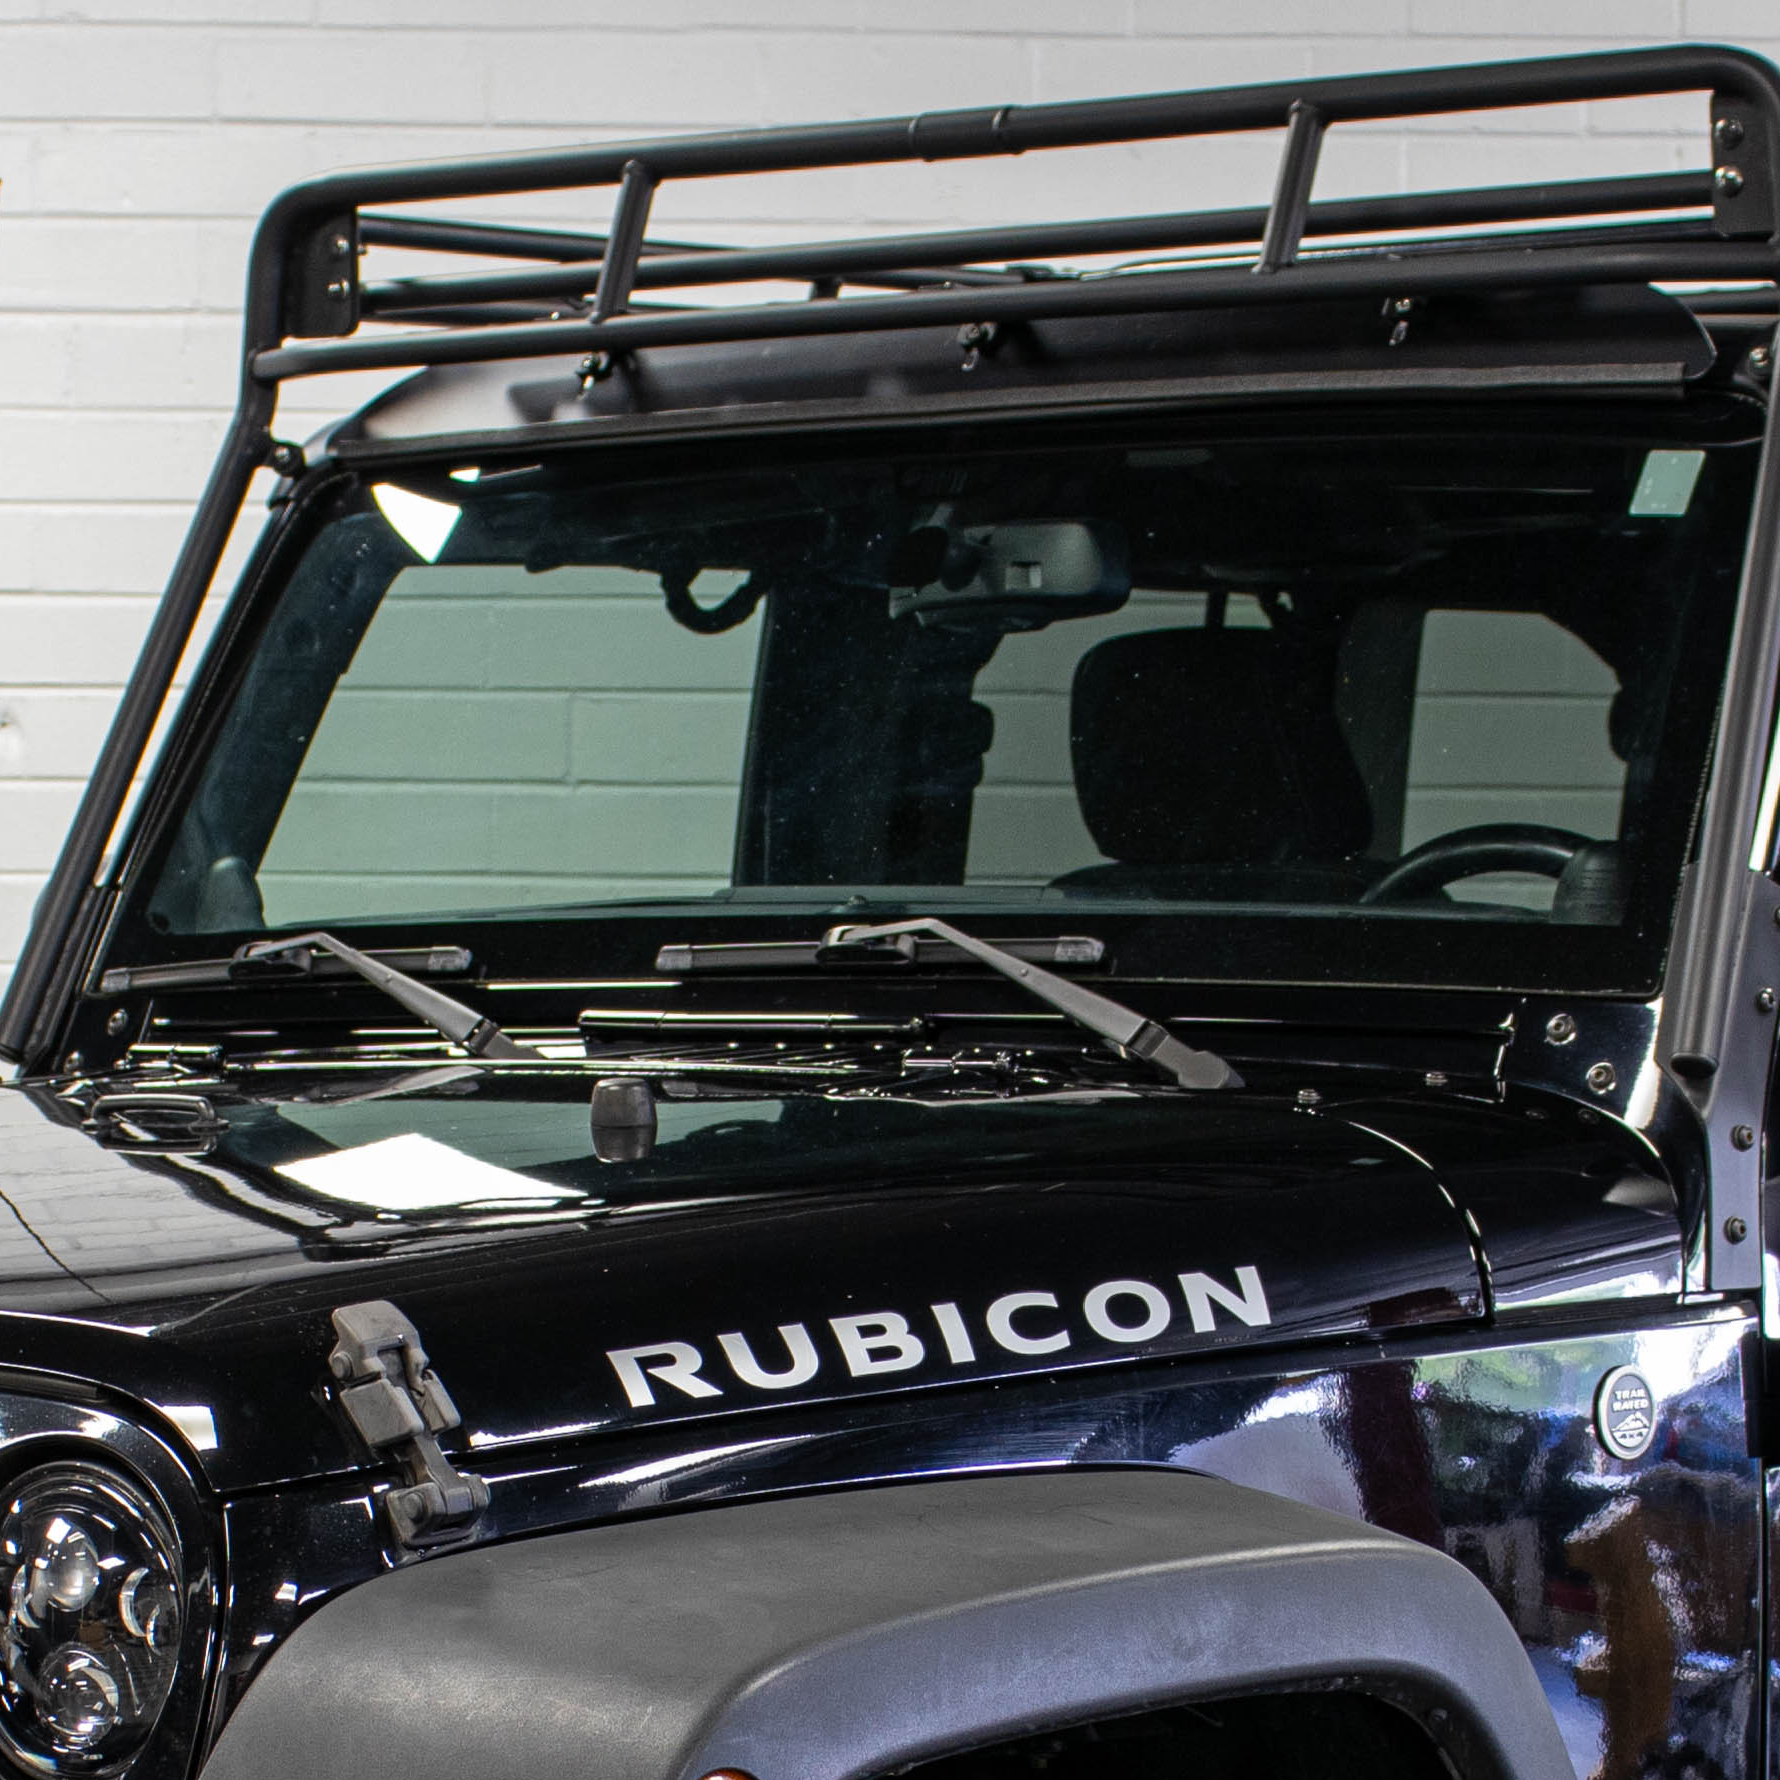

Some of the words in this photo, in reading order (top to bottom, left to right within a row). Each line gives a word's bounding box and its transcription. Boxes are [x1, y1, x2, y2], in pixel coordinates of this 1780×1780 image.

[606, 1266, 1271, 1408] RUBICON
[1615, 1388, 1646, 1400] TRAIL
[1613, 1400, 1649, 1412] RATED
